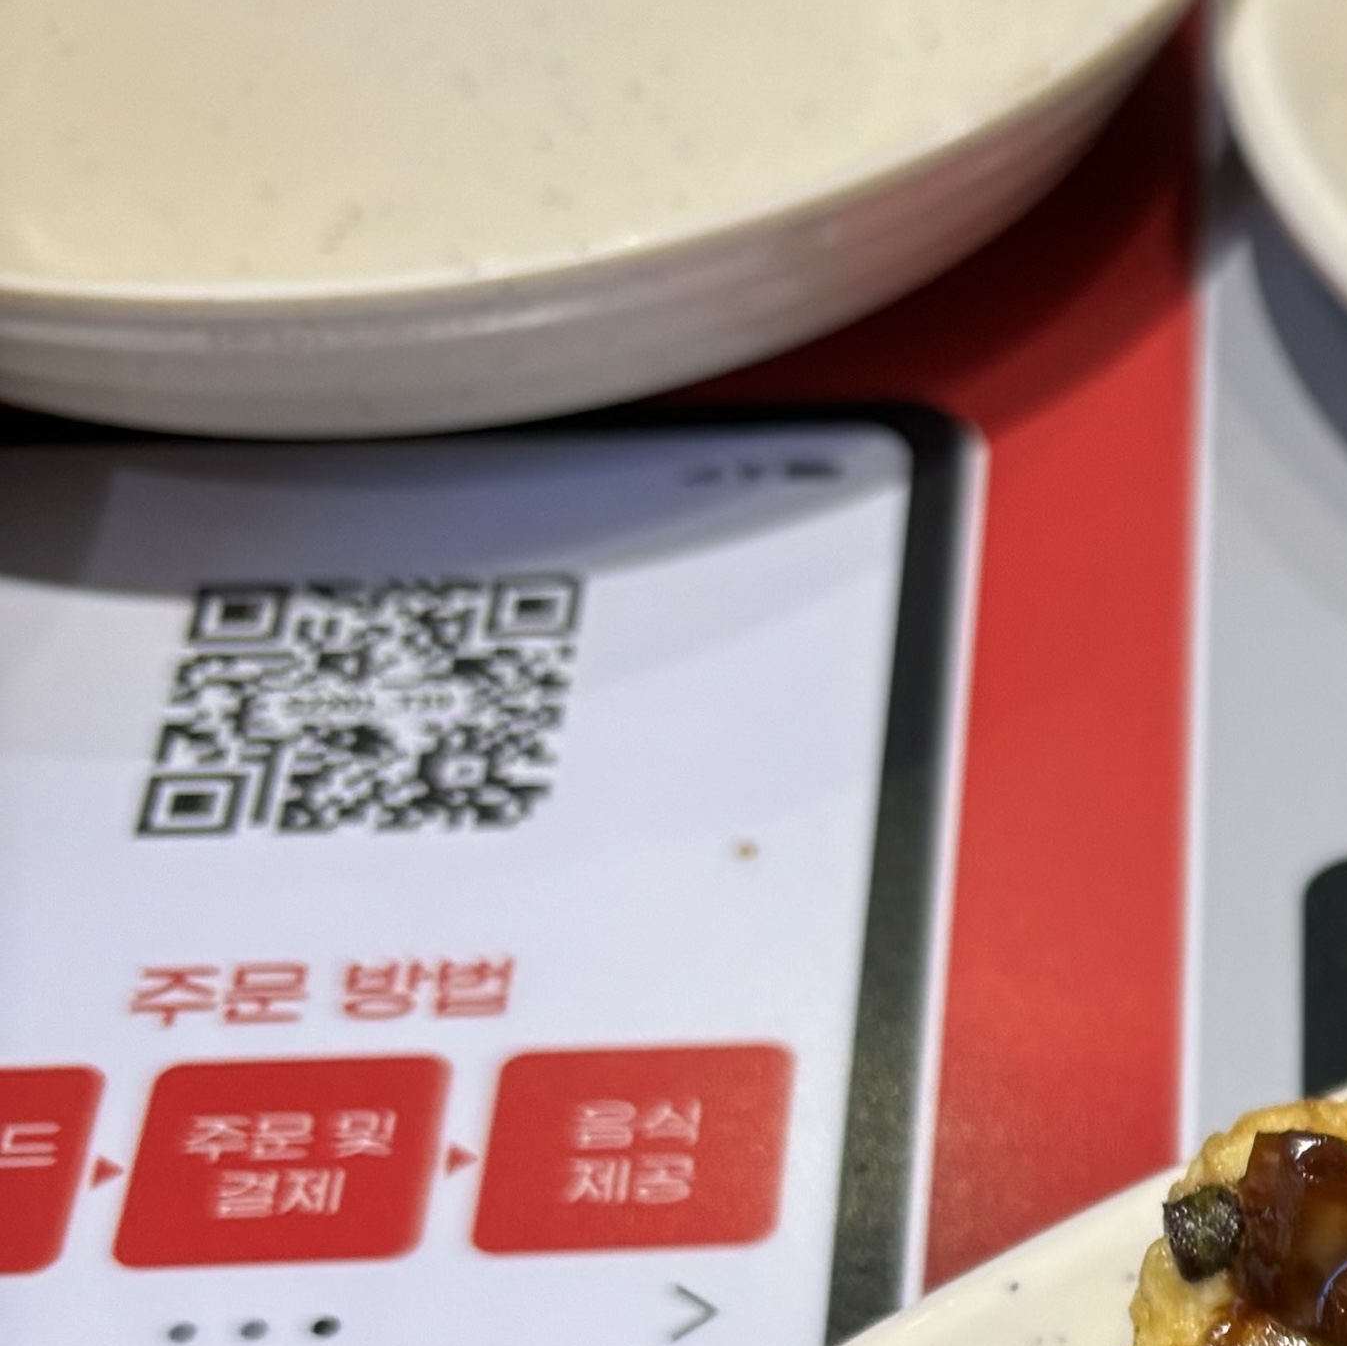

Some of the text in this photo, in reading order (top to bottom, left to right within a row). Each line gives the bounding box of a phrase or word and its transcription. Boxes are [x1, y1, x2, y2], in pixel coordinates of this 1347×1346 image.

[129, 957, 515, 1027] 주문 방법
[185, 1109, 397, 1163] 주문 및
[573, 1098, 702, 1149] 음식
[213, 1168, 346, 1220] 결제
[565, 1154, 695, 1204] 제공
